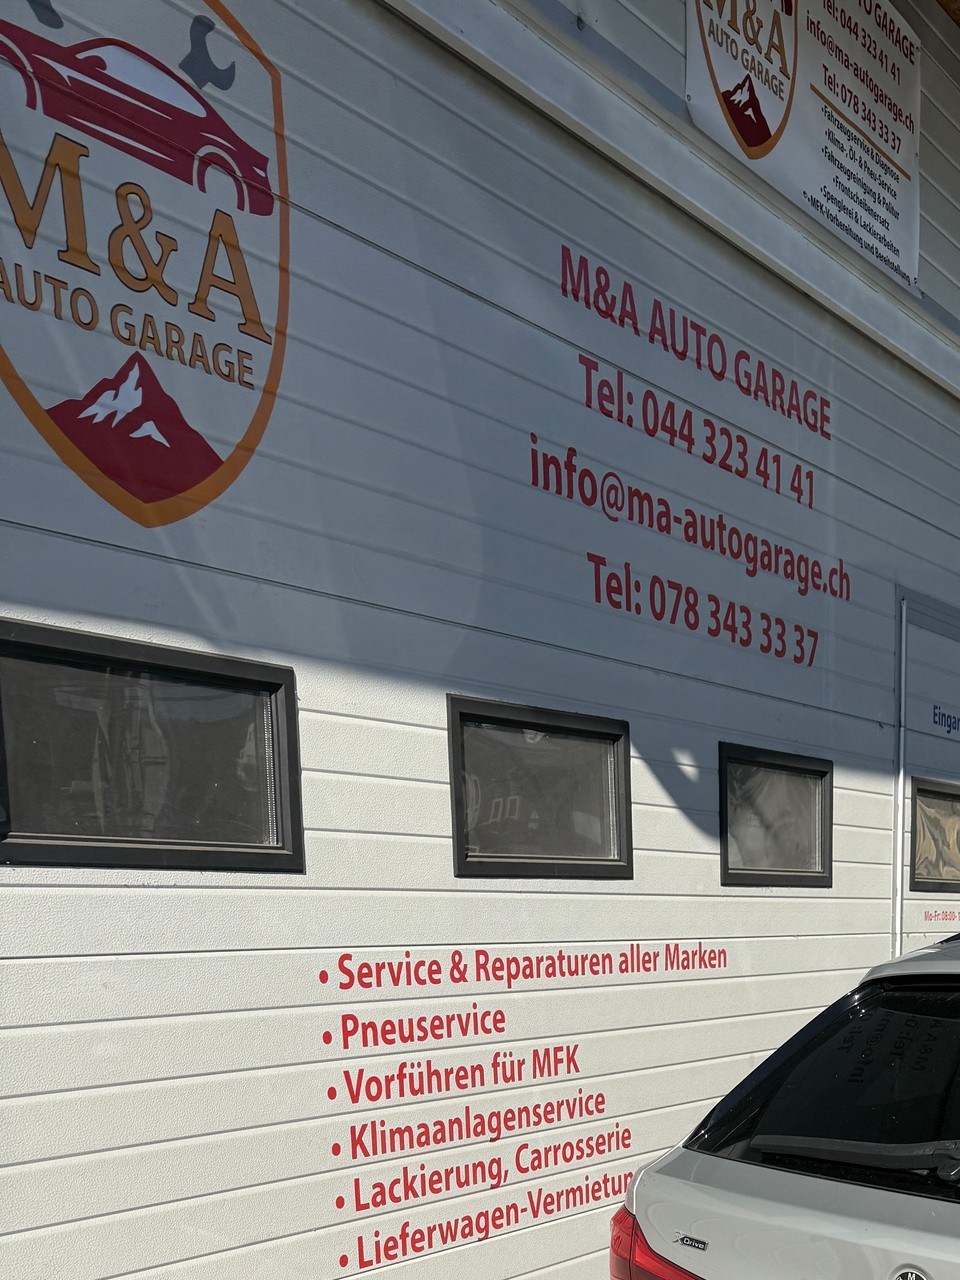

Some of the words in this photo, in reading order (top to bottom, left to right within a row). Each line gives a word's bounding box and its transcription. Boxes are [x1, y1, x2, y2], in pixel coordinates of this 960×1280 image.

[707, 18, 739, 60] AUTO
[741, 48, 785, 102] GARAGE
[806, 9, 915, 134] info@ma-autogarage.ch
[840, 8, 859, 41] 044
[861, 27, 877, 60] 323
[878, 48, 888, 73] 41
[890, 62, 900, 86] 41
[874, 3, 915, 66] GARAGE
[822, 63, 839, 98] Tel:
[840, 83, 860, 115] 078
[861, 101, 877, 133] 343
[878, 119, 889, 144] 33
[890, 131, 902, 155] 37
[858, 156, 863, 170] &
[870, 147, 875, 161] &
[875, 152, 900, 184] Diagnose
[877, 193, 882, 206] &
[0, 127, 273, 345] M&A
[823, 185, 854, 219] Spenglerei
[854, 211, 859, 225] &
[860, 215, 900, 258] Lackierarbeiten
[110, 303, 255, 391] GARAGE
[560, 244, 641, 336] M&A
[648, 299, 727, 382] AUTO
[734, 349, 832, 441] GARAGE
[578, 353, 634, 428] Tel:
[642, 389, 696, 455] 044
[702, 418, 749, 479] 323
[755, 446, 781, 495] 41
[790, 464, 815, 509] 41
[530, 432, 852, 601] info@ma-autogarage.ch
[586, 552, 642, 616] Tel:
[649, 574, 700, 632] 078
[707, 593, 753, 648] 343
[759, 612, 787, 659] 33
[793, 624, 819, 668] 37
[338, 950, 442, 990] Service
[449, 949, 468, 984] &
[475, 949, 613, 989] Reparaturen
[618, 943, 660, 974] aller
[664, 943, 728, 971] Marken
[341, 1003, 506, 1050] Pneuservice
[343, 1059, 485, 1104] Vorführen
[491, 1051, 526, 1085] für
[532, 1044, 580, 1079] MFK
[350, 1088, 606, 1160] Klimaanlagenservice
[353, 1156, 509, 1212] Lackierung,
[515, 1122, 632, 1174] Carrosserie
[357, 1171, 634, 1270] Lieferwagen-Vermietun
